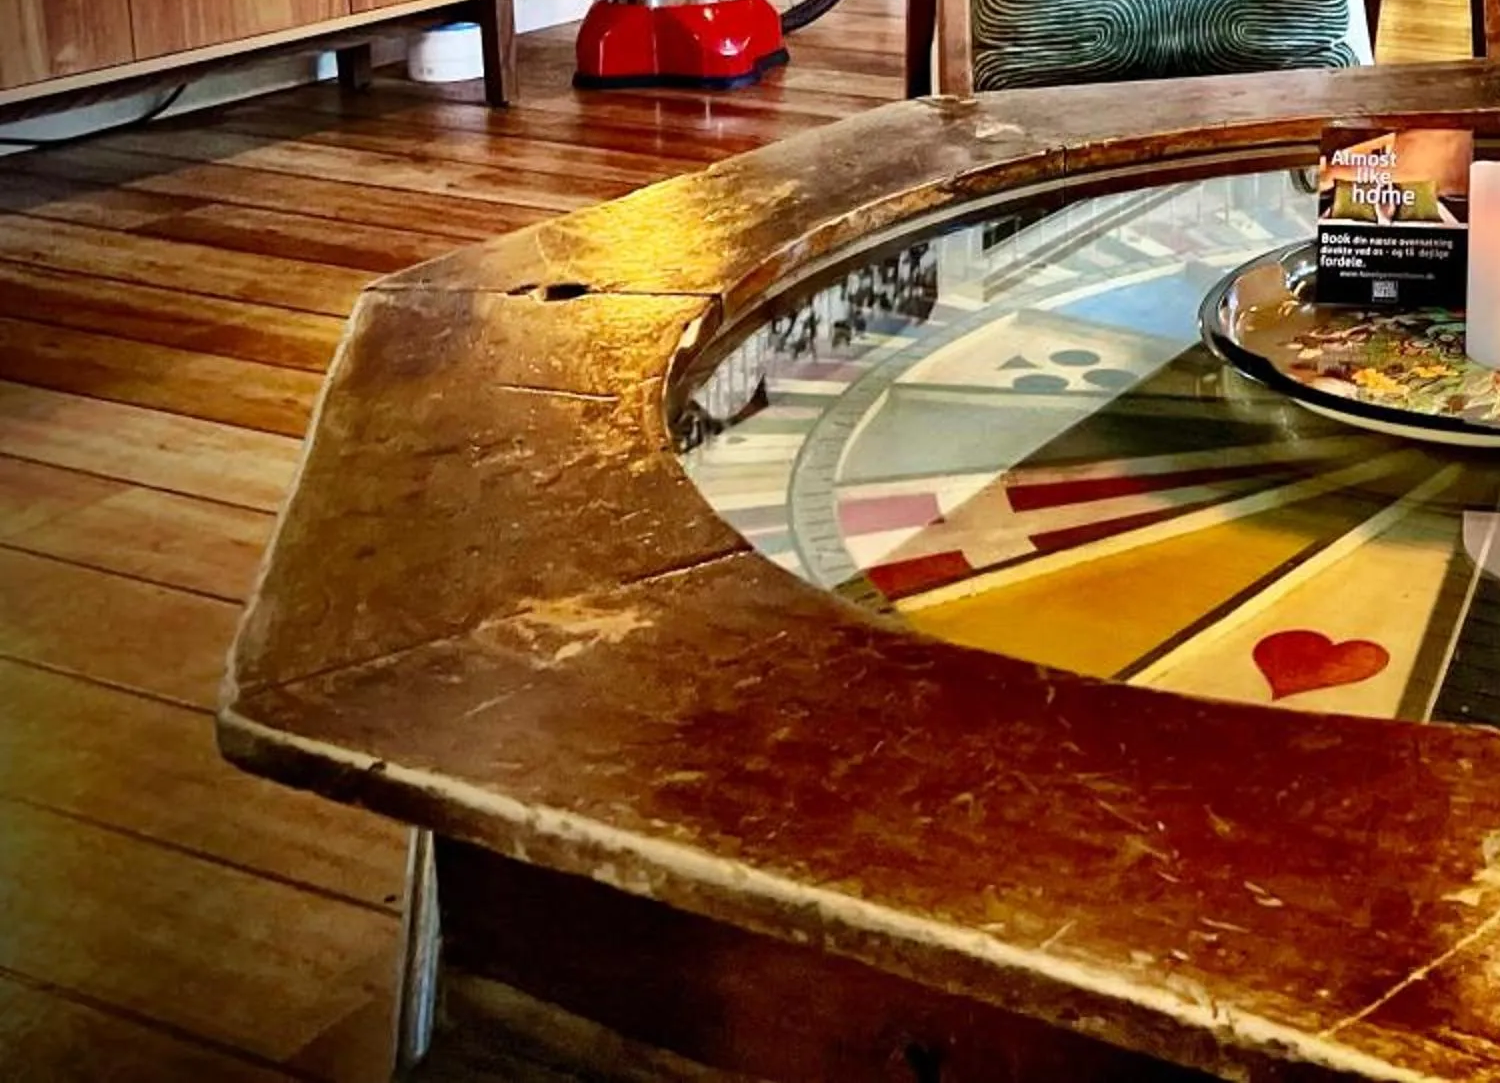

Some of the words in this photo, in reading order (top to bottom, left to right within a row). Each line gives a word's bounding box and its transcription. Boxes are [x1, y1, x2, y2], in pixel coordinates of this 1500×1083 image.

[1331, 149, 1397, 166] Almost
[1357, 167, 1391, 183] like
[1352, 184, 1415, 205] home
[1321, 232, 1350, 244] Book
[1353, 246, 1371, 256] ved
